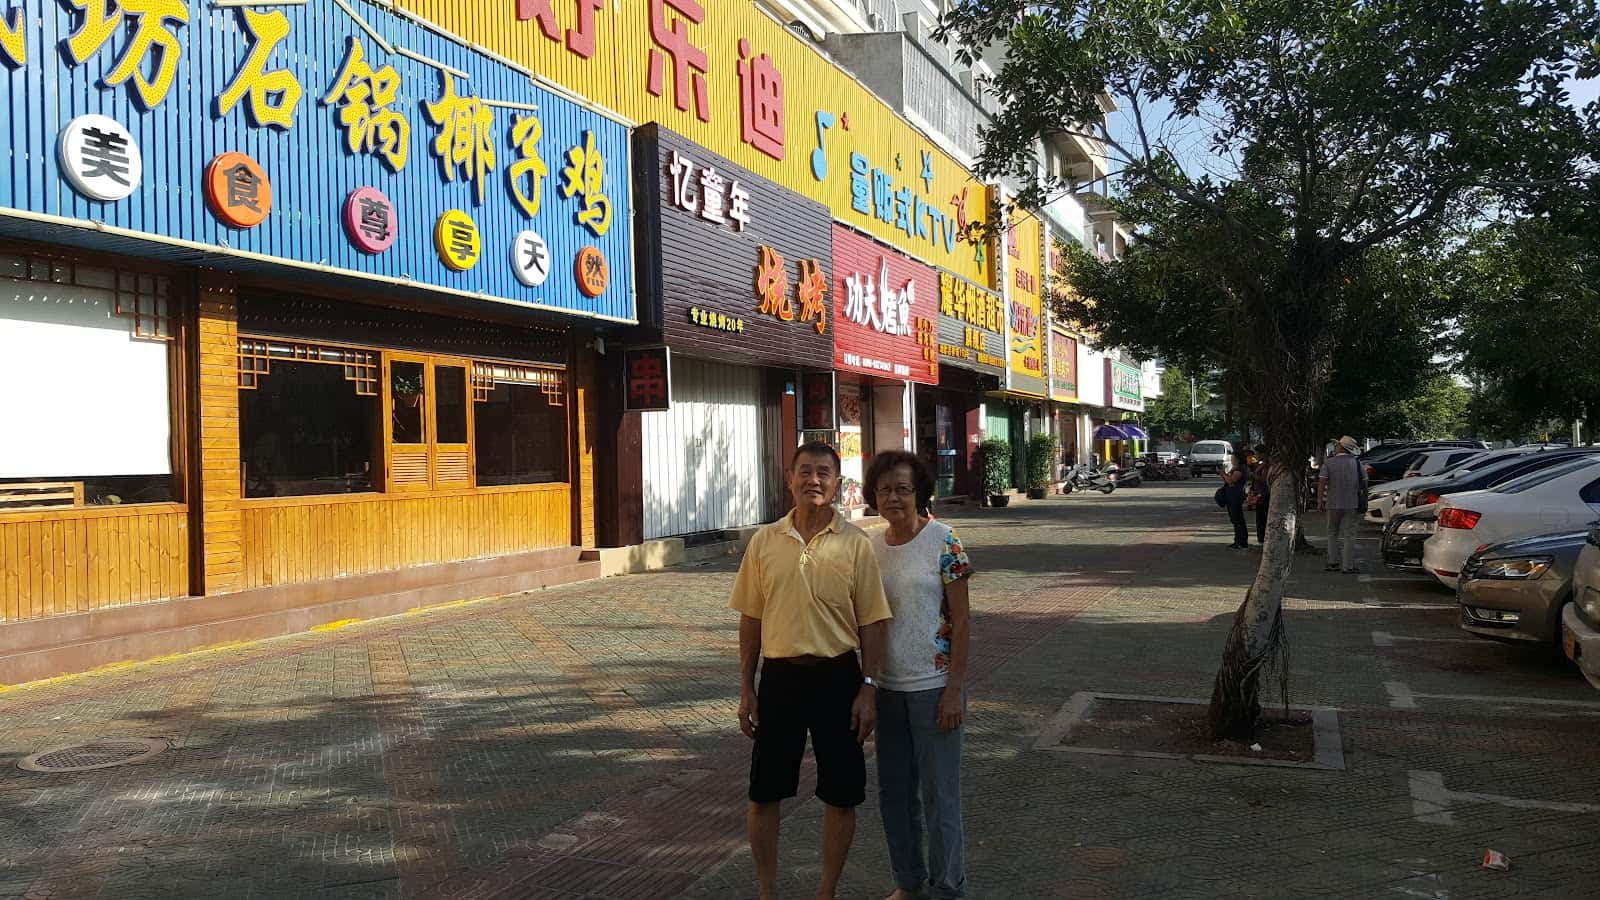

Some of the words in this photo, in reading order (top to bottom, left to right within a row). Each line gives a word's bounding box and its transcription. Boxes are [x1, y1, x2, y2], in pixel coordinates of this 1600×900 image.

[0, 0, 611, 235] 坊石锅椰子鸡
[670, 150, 750, 232] 忆童年
[758, 245, 827, 335] 烧烤
